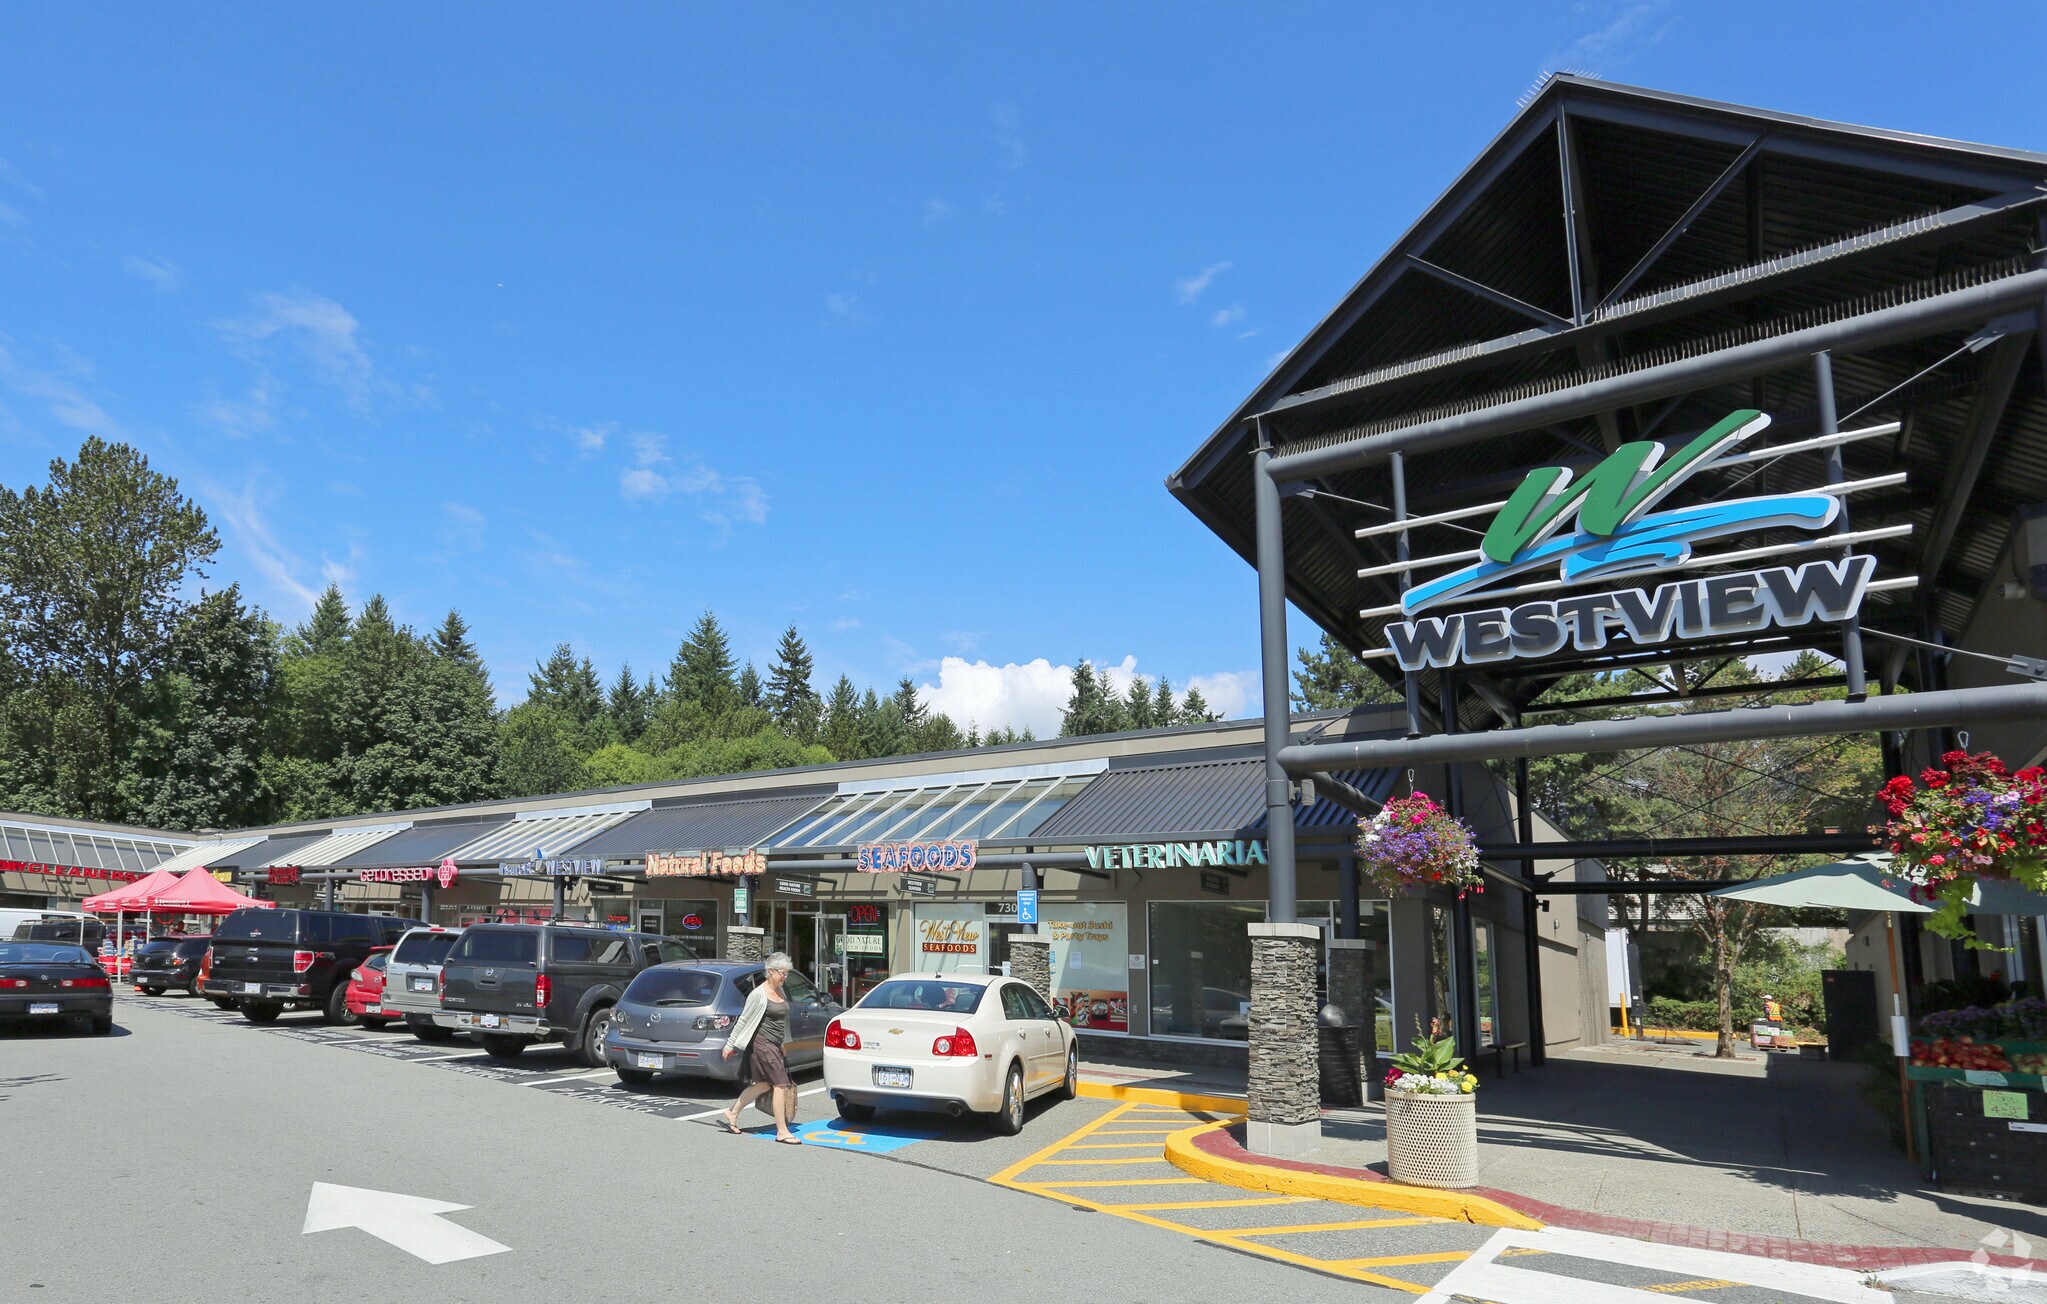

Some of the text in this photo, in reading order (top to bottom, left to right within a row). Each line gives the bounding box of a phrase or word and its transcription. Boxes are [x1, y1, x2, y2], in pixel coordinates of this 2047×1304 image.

[1385, 555, 1877, 671] WESTVIEW
[645, 849, 766, 877] Natural Foods
[858, 842, 975, 872] SEAFOODS
[1084, 840, 1269, 869] VETERINARIA
[28, 862, 137, 882] CLEANERS
[545, 859, 606, 876] WESTVIEW
[850, 905, 878, 922] OPEN
[920, 920, 980, 941] West View
[1088, 920, 1113, 930] Sushi
[1060, 932, 1084, 942] Party
[1085, 932, 1109, 942] Trays
[923, 943, 976, 953] SEAFOODS
[543, 1087, 663, 1113] PARKING
